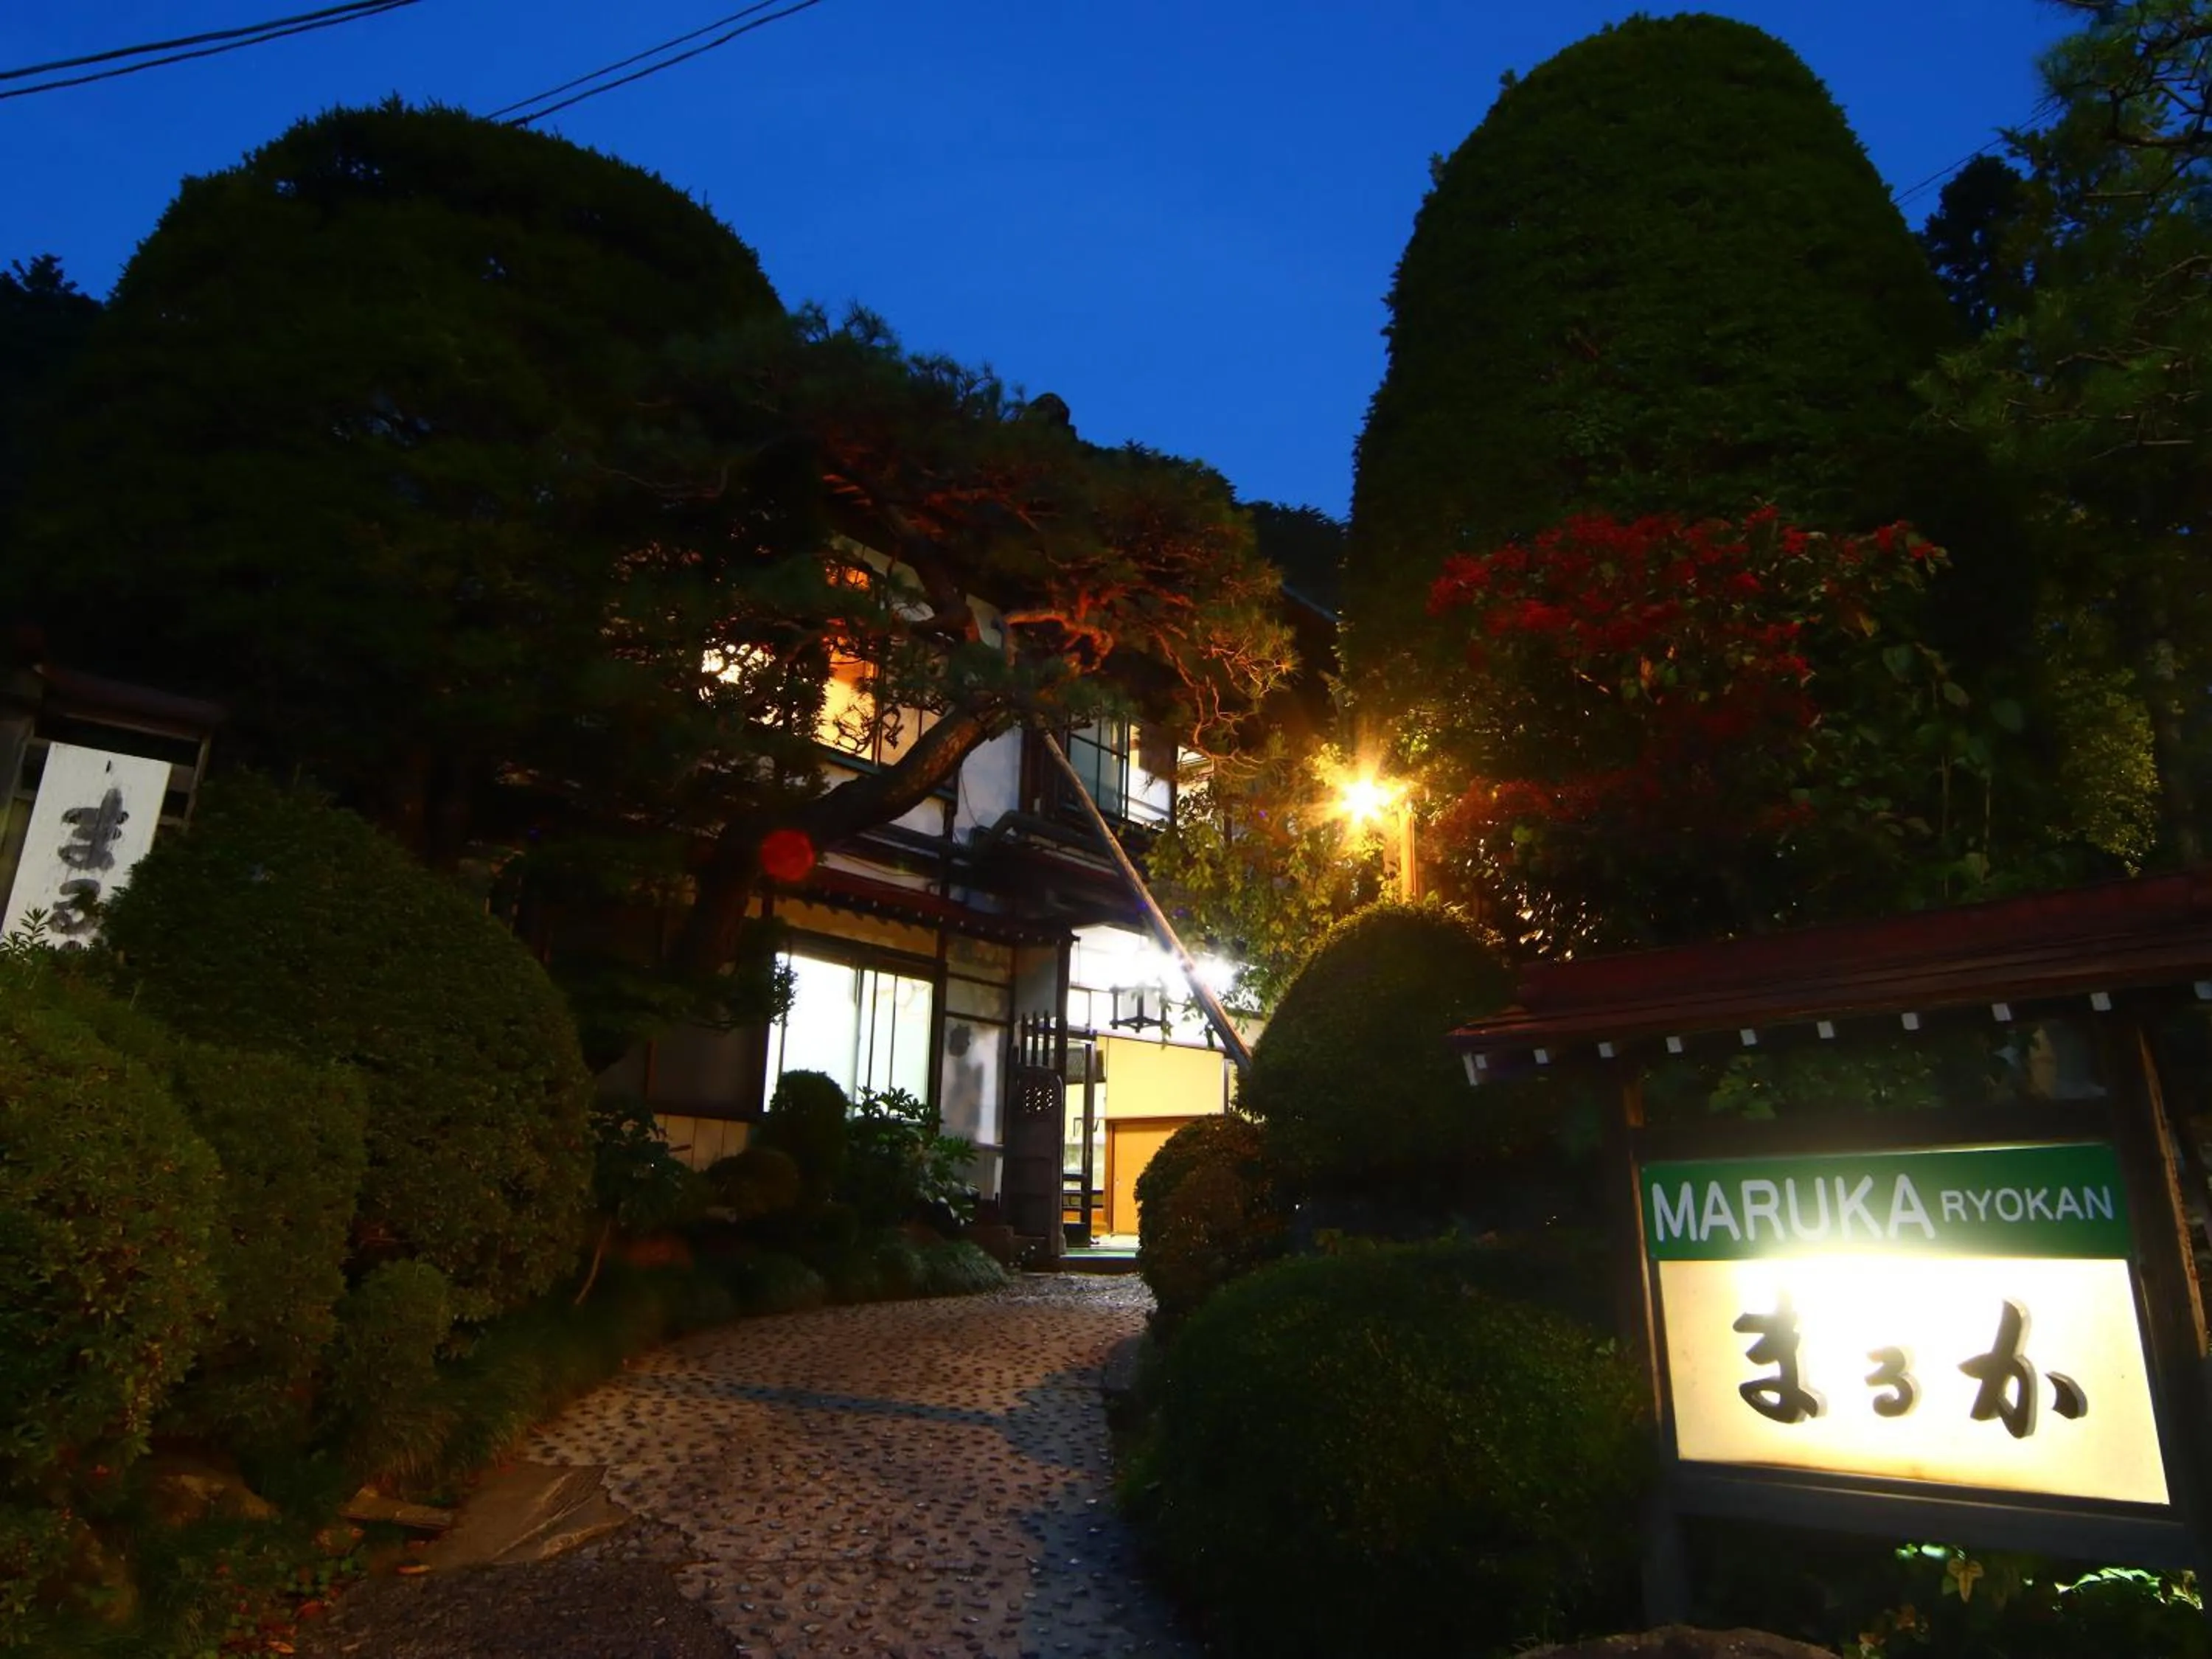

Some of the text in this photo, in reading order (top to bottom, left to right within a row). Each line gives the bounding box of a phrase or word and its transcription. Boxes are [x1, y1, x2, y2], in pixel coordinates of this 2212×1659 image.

[47, 787, 131, 950] まる
[1651, 1172, 2115, 1242] MARUKA RYOKAN
[1733, 1295, 2089, 1439] まるか
